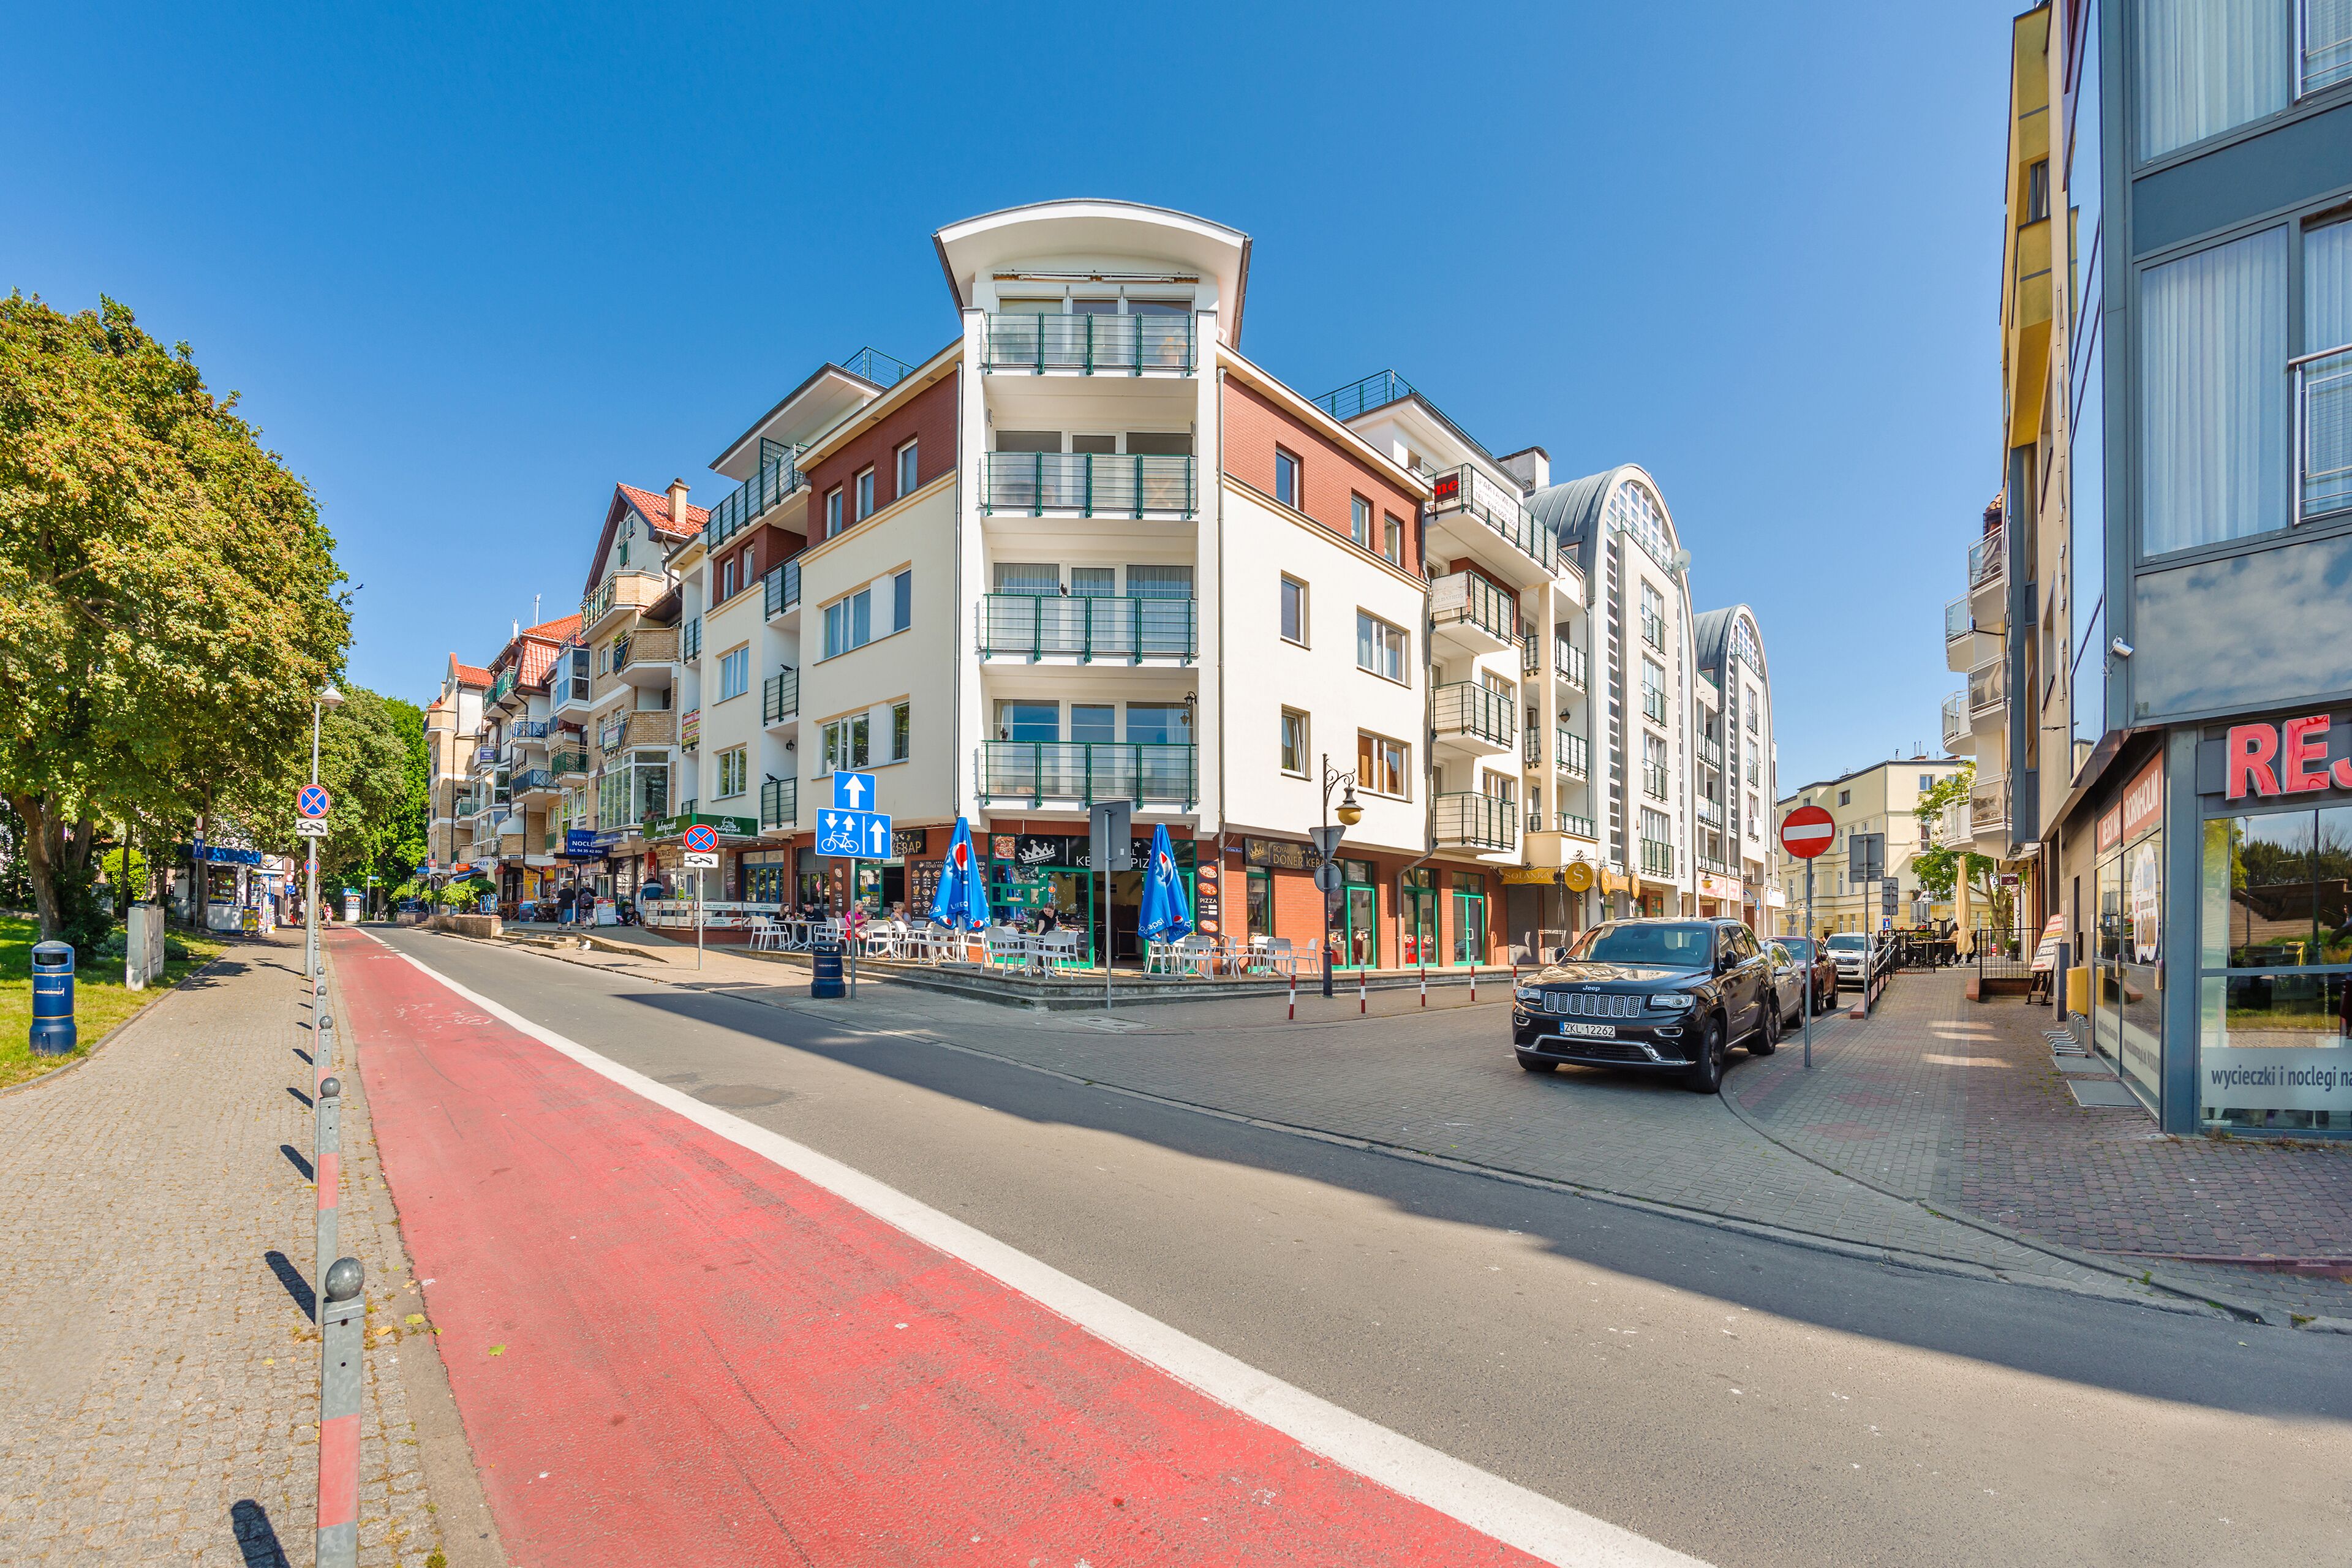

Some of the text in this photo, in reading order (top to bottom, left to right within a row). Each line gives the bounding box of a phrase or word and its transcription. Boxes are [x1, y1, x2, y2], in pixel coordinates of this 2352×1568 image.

[1475, 491, 1486, 505] TEL.
[1434, 593, 1464, 603] ALBATROS
[2125, 769, 2158, 830] BORNHOLM
[655, 818, 677, 834] Imbryczek
[2113, 807, 2120, 838] NA
[1273, 854, 1325, 868] DONER KEBA
[1505, 871, 1550, 880] SOLANKA
[1573, 869, 1583, 881] S
[1148, 918, 1165, 930] epsi
[1564, 1023, 1581, 1033] ZKL
[1585, 1025, 1614, 1036] 12262
[2211, 1065, 2275, 1090] wycieczki
[2280, 1066, 2284, 1085] i
[2288, 1065, 2337, 1092] noclegi
